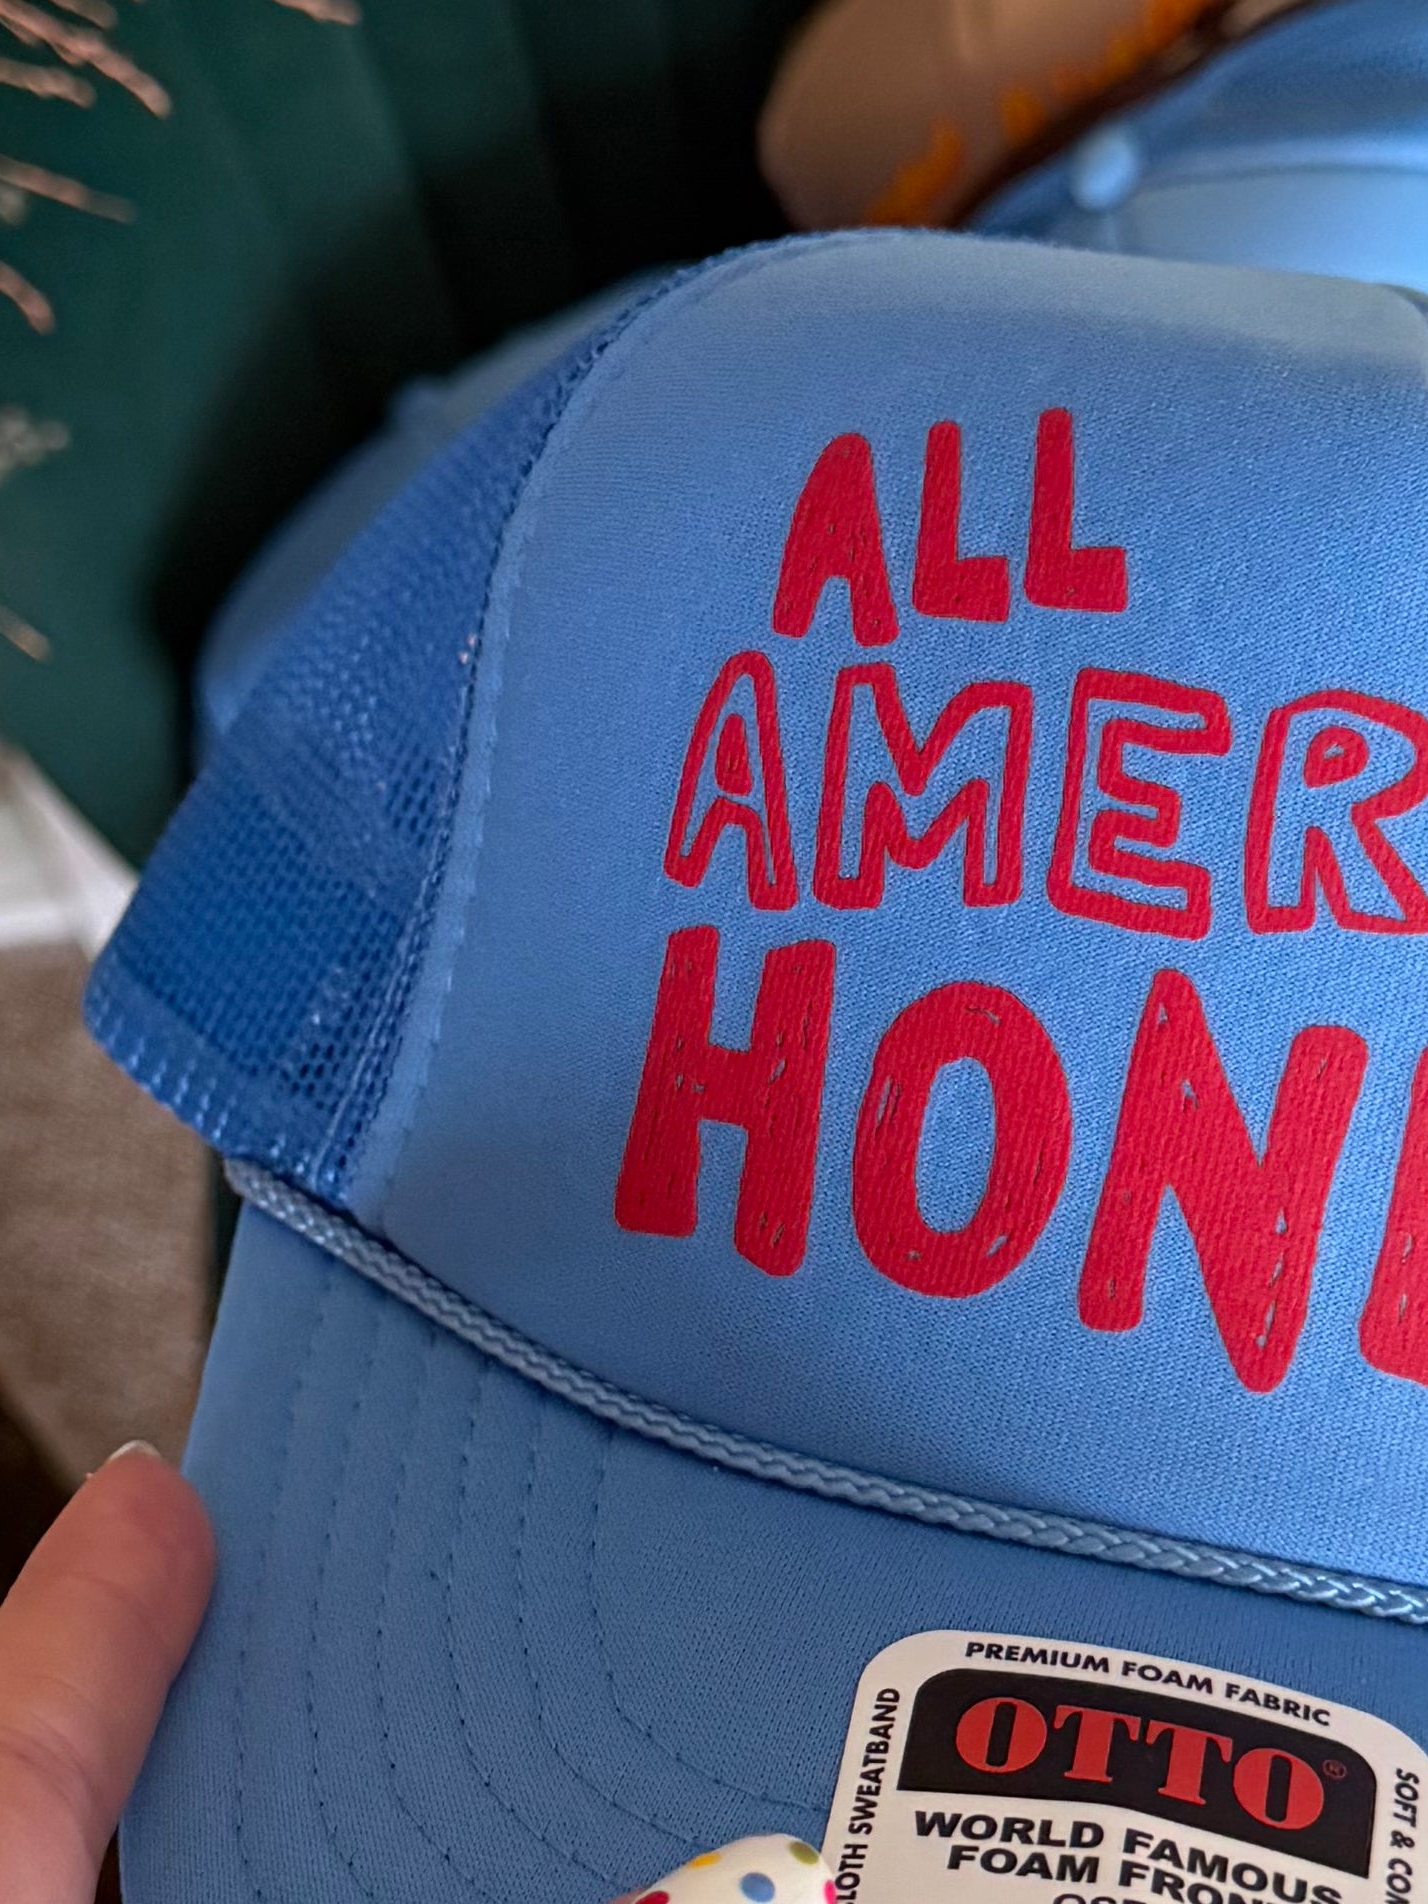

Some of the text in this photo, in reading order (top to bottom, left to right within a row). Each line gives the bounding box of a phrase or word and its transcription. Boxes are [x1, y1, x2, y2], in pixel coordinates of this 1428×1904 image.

[772, 406, 1129, 646] ALL
[965, 1640, 1332, 1727] PREMIUM FOAM FABRIC
[848, 1687, 901, 1836] SWEATBAND
[1392, 1768, 1420, 1828] SOFT
[915, 1810, 1105, 1849] WORLD
[1388, 1829, 1416, 1849] &
[947, 1844, 1100, 1884] FOAM
